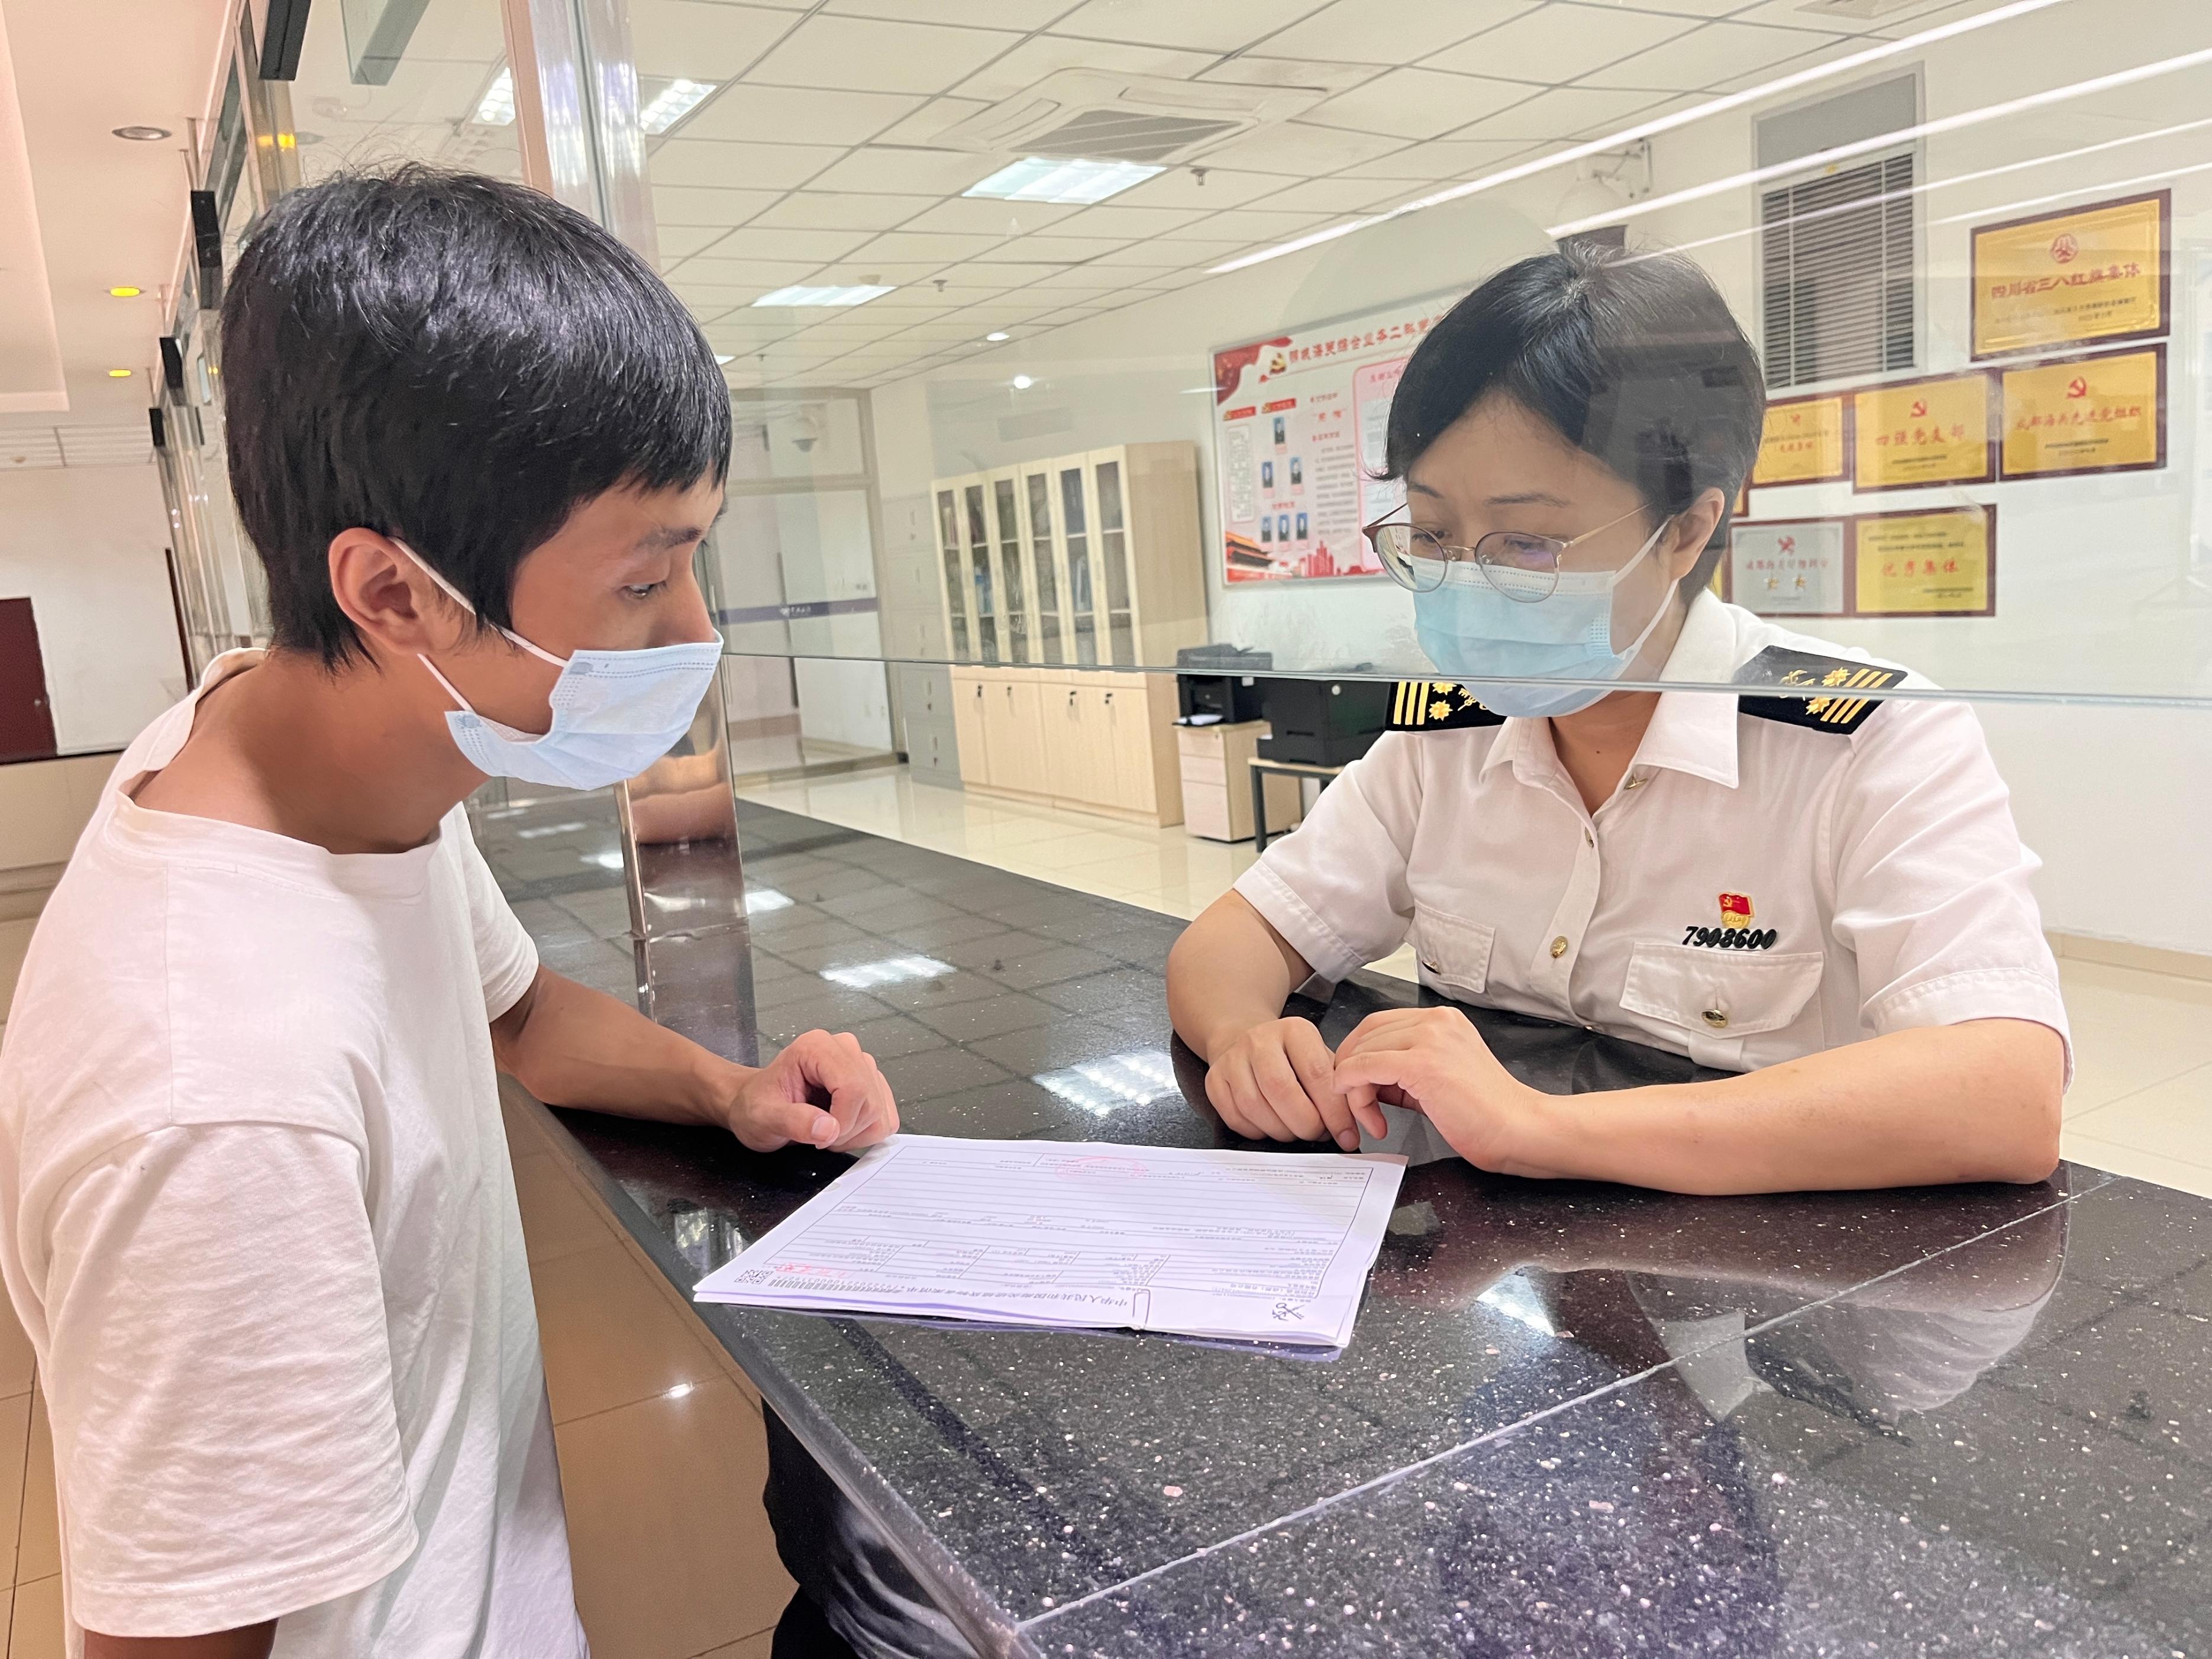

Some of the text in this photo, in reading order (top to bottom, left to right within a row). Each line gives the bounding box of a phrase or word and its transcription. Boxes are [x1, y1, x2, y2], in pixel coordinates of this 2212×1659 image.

[1991, 262, 2140, 299] 四川省三八红旗集体
[1875, 424, 1965, 446] 四强党支部
[1681, 926, 1777, 950] 7908600
